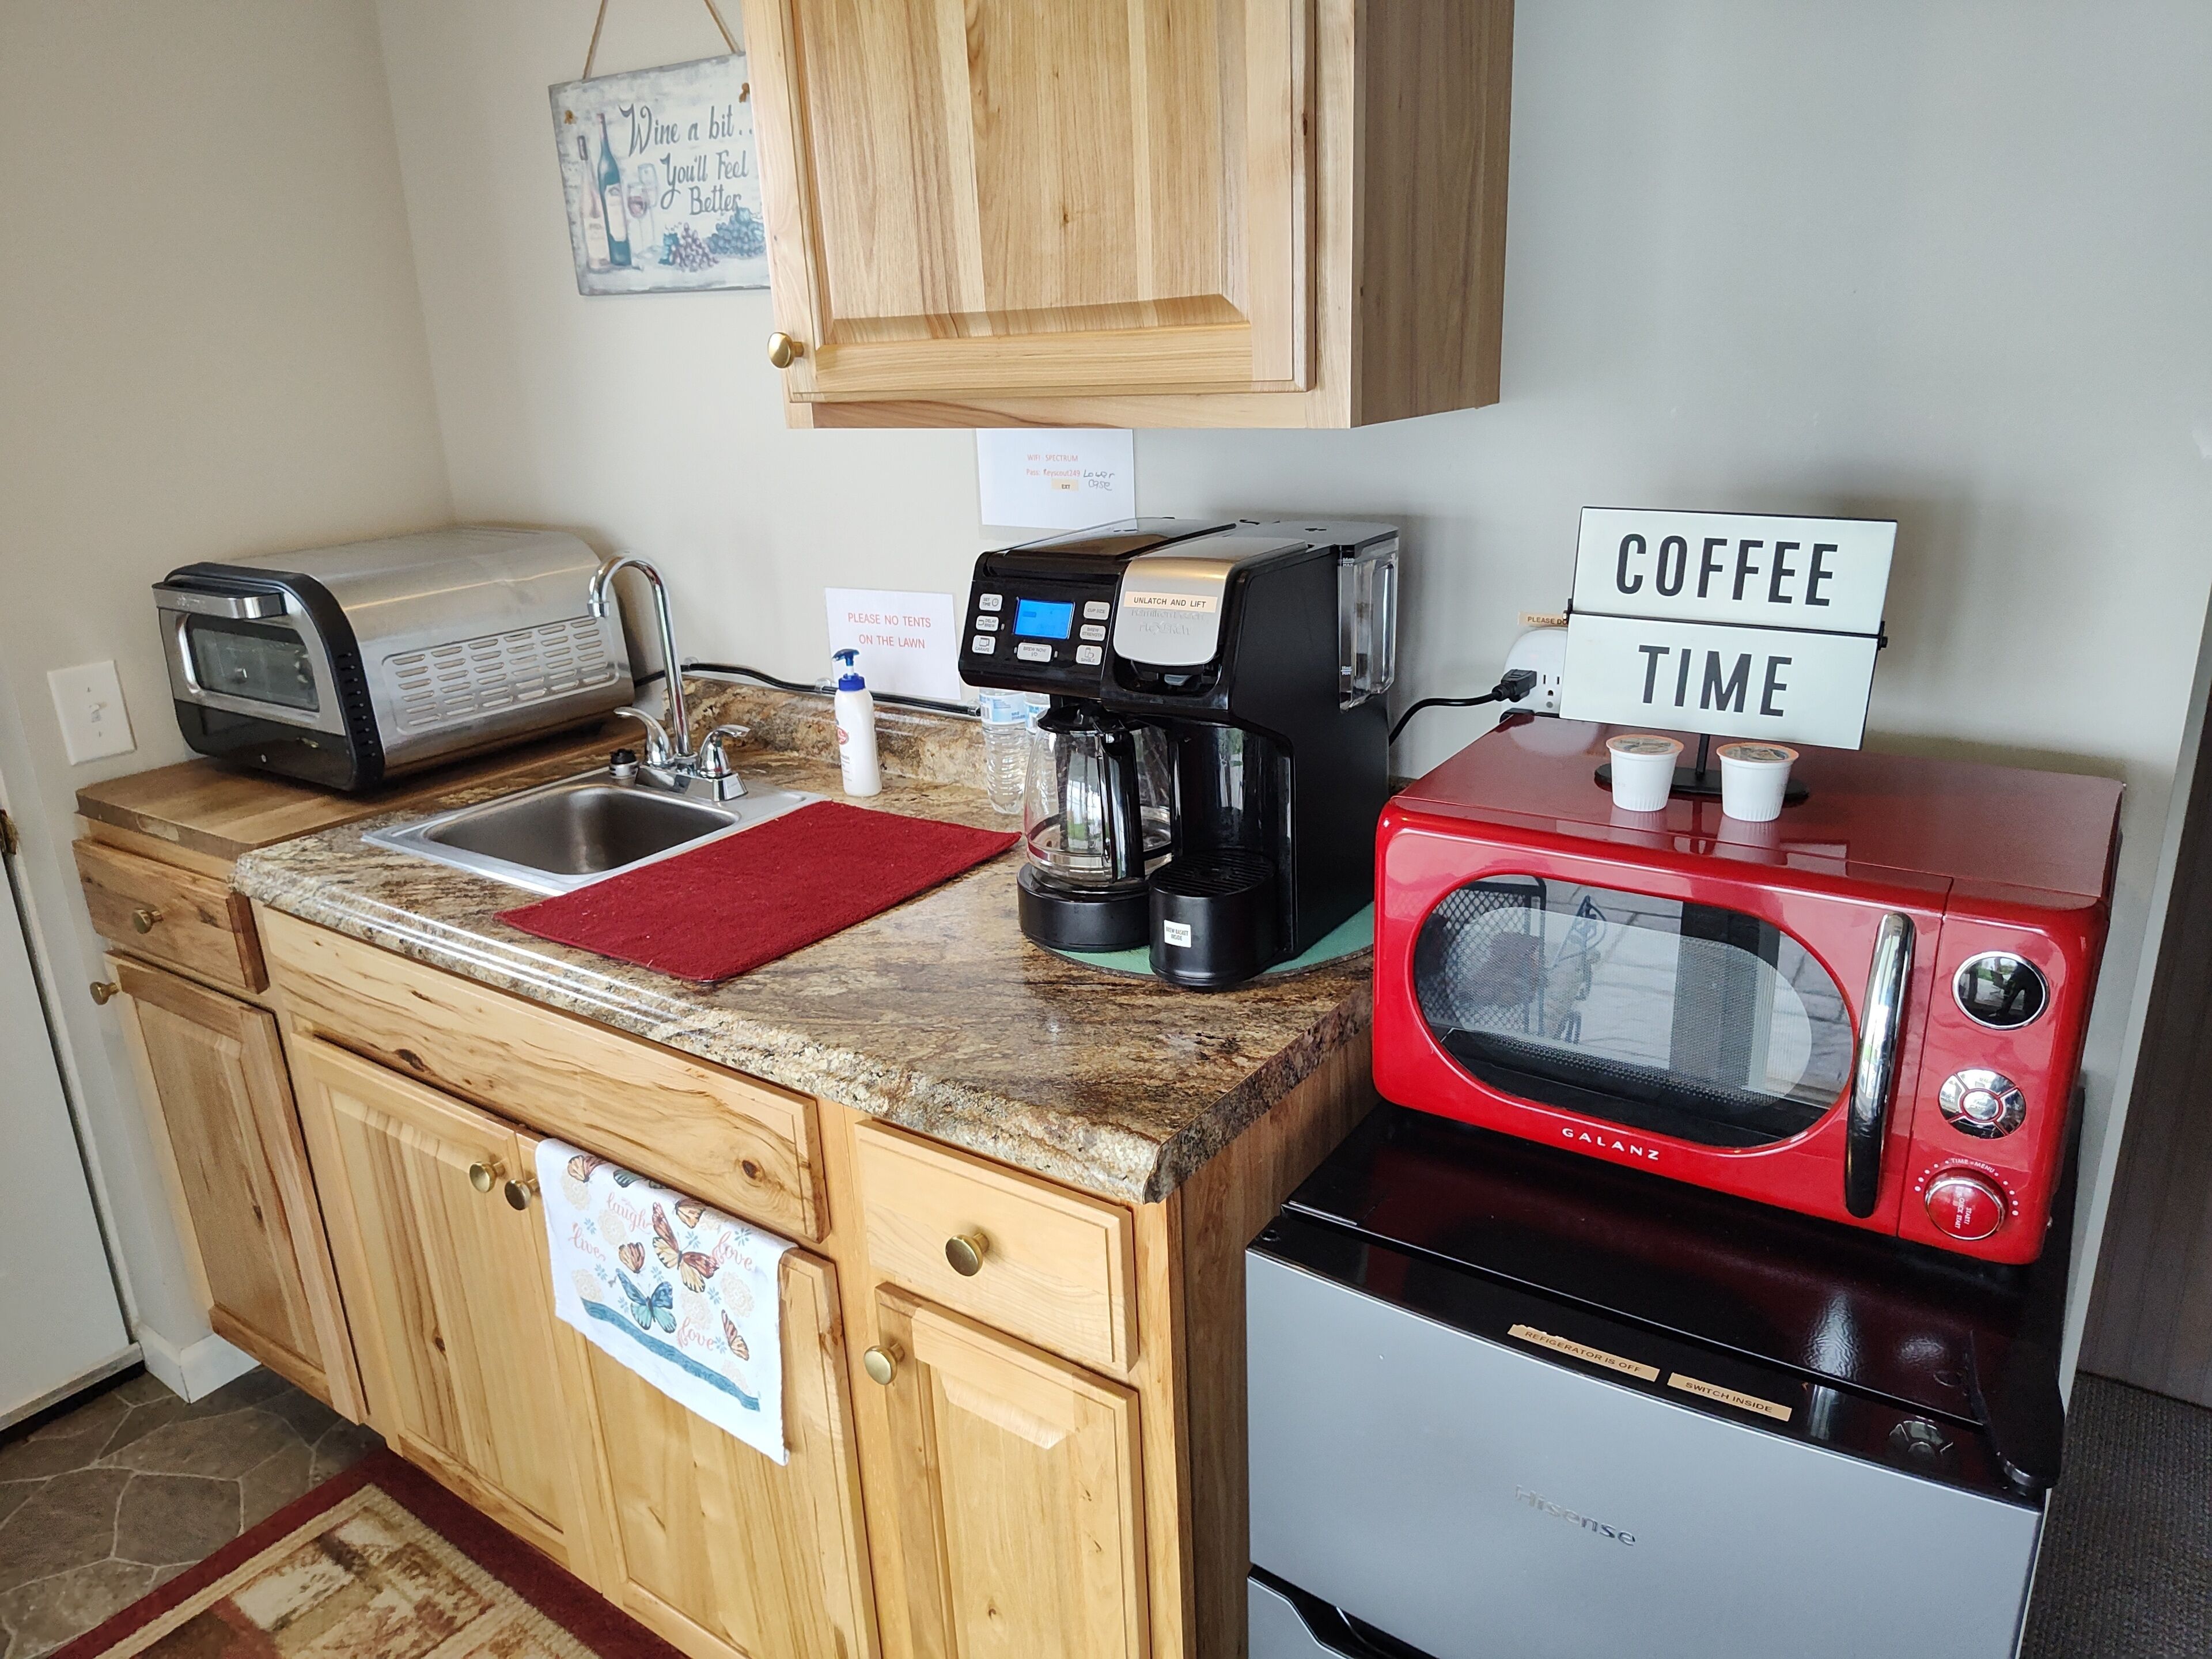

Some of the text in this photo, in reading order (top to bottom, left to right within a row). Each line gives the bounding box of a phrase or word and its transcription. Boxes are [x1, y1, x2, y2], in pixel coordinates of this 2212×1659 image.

[619, 104, 680, 157] Wine
[688, 122, 699, 141] a
[659, 150, 749, 210] You'll Feel
[688, 185, 742, 215] Better
[1616, 533, 1839, 607] COFFEE
[848, 612, 931, 628] PLEASE NO TENTS
[1134, 597, 1206, 608] UNLATCH AND LIFT
[859, 634, 926, 649] ON THE LAWN
[1639, 643, 1793, 717] TIME
[1562, 1128, 1659, 1160] GALANZ
[1974, 1161, 1995, 1173] MENU
[607, 1191, 652, 1232] laugh
[568, 1222, 605, 1261] live
[712, 1230, 753, 1271] love
[677, 1316, 714, 1350] love
[1525, 1331, 1641, 1373] REFIGERATOR IS OFF
[1685, 1382, 1773, 1413] SWITCH INSIDE
[1515, 1484, 1635, 1547] Hisense
